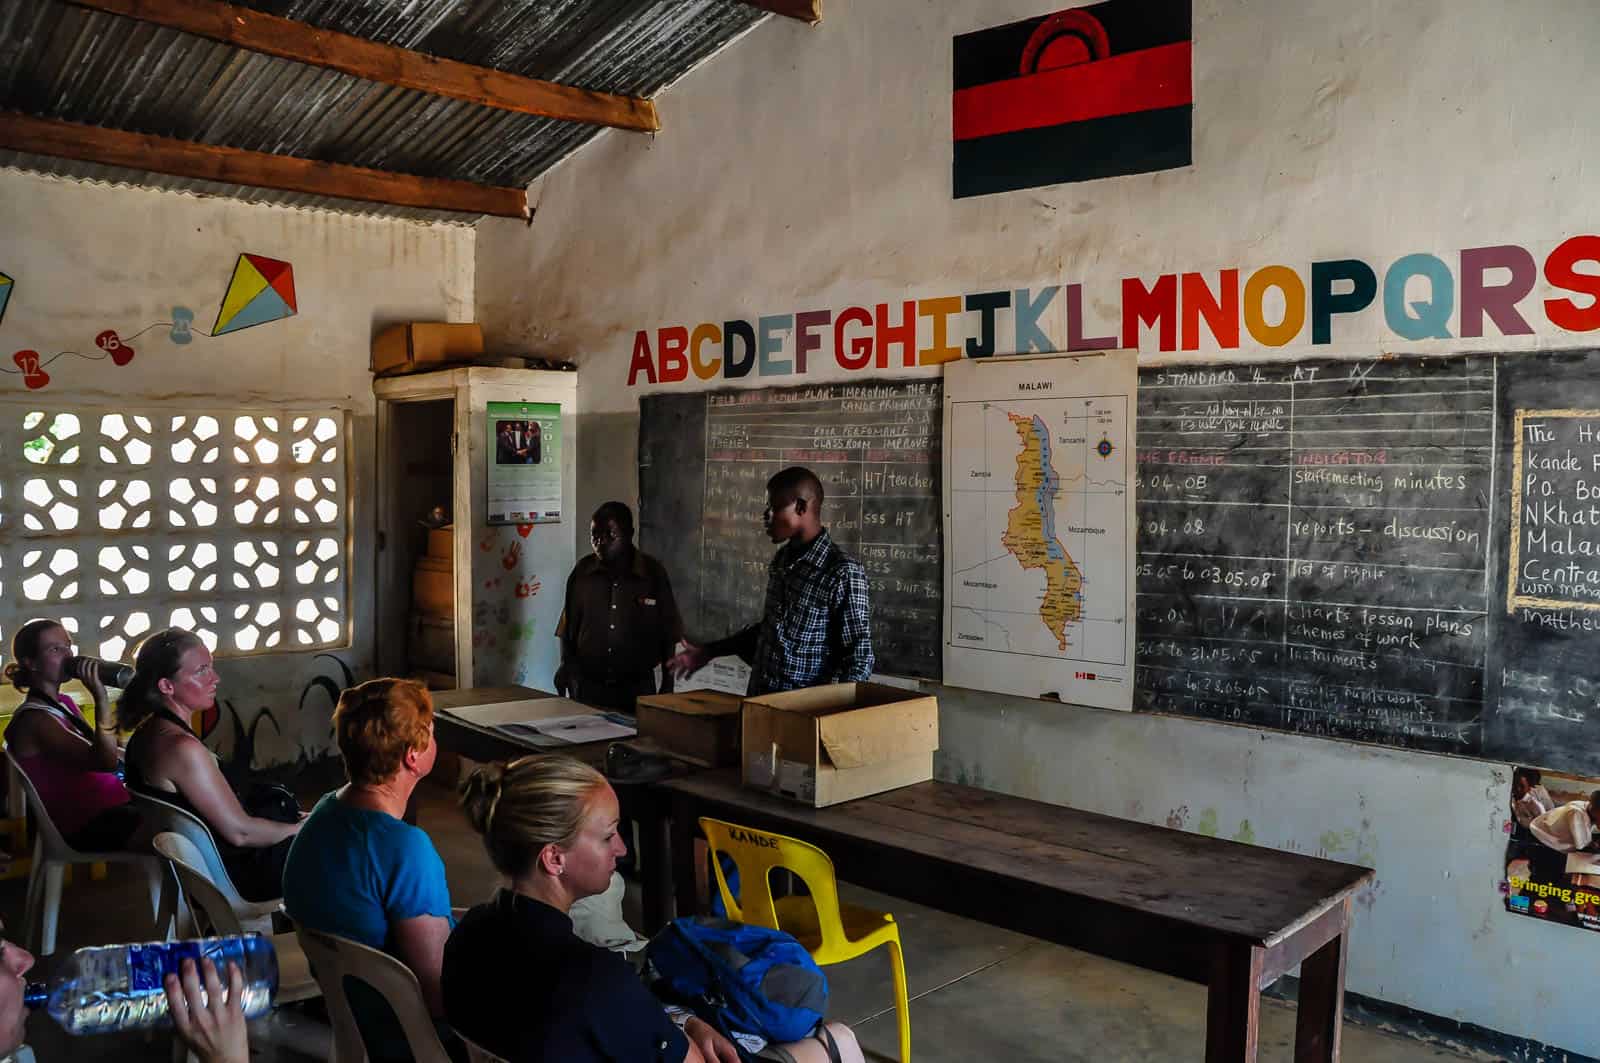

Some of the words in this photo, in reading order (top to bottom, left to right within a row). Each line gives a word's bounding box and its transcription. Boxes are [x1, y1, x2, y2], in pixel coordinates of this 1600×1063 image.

[101, 335, 119, 350] 16
[20, 357, 40, 377] 12
[1018, 382, 1053, 392] MALAWI
[1156, 371, 1236, 385] STANDARD
[906, 384, 926, 396] THE
[1524, 424, 1556, 443] The
[1528, 448, 1582, 472] Kande
[1394, 470, 1468, 490] minutes
[1068, 525, 1106, 535] Mozambique
[1384, 516, 1480, 553] discussion
[1522, 559, 1600, 585] Centra
[1360, 608, 1414, 629] lesson
[1424, 611, 1474, 636] plans
[1375, 631, 1421, 649] work
[729, 828, 777, 848] KANDE
[1511, 877, 1572, 902] Bringing
